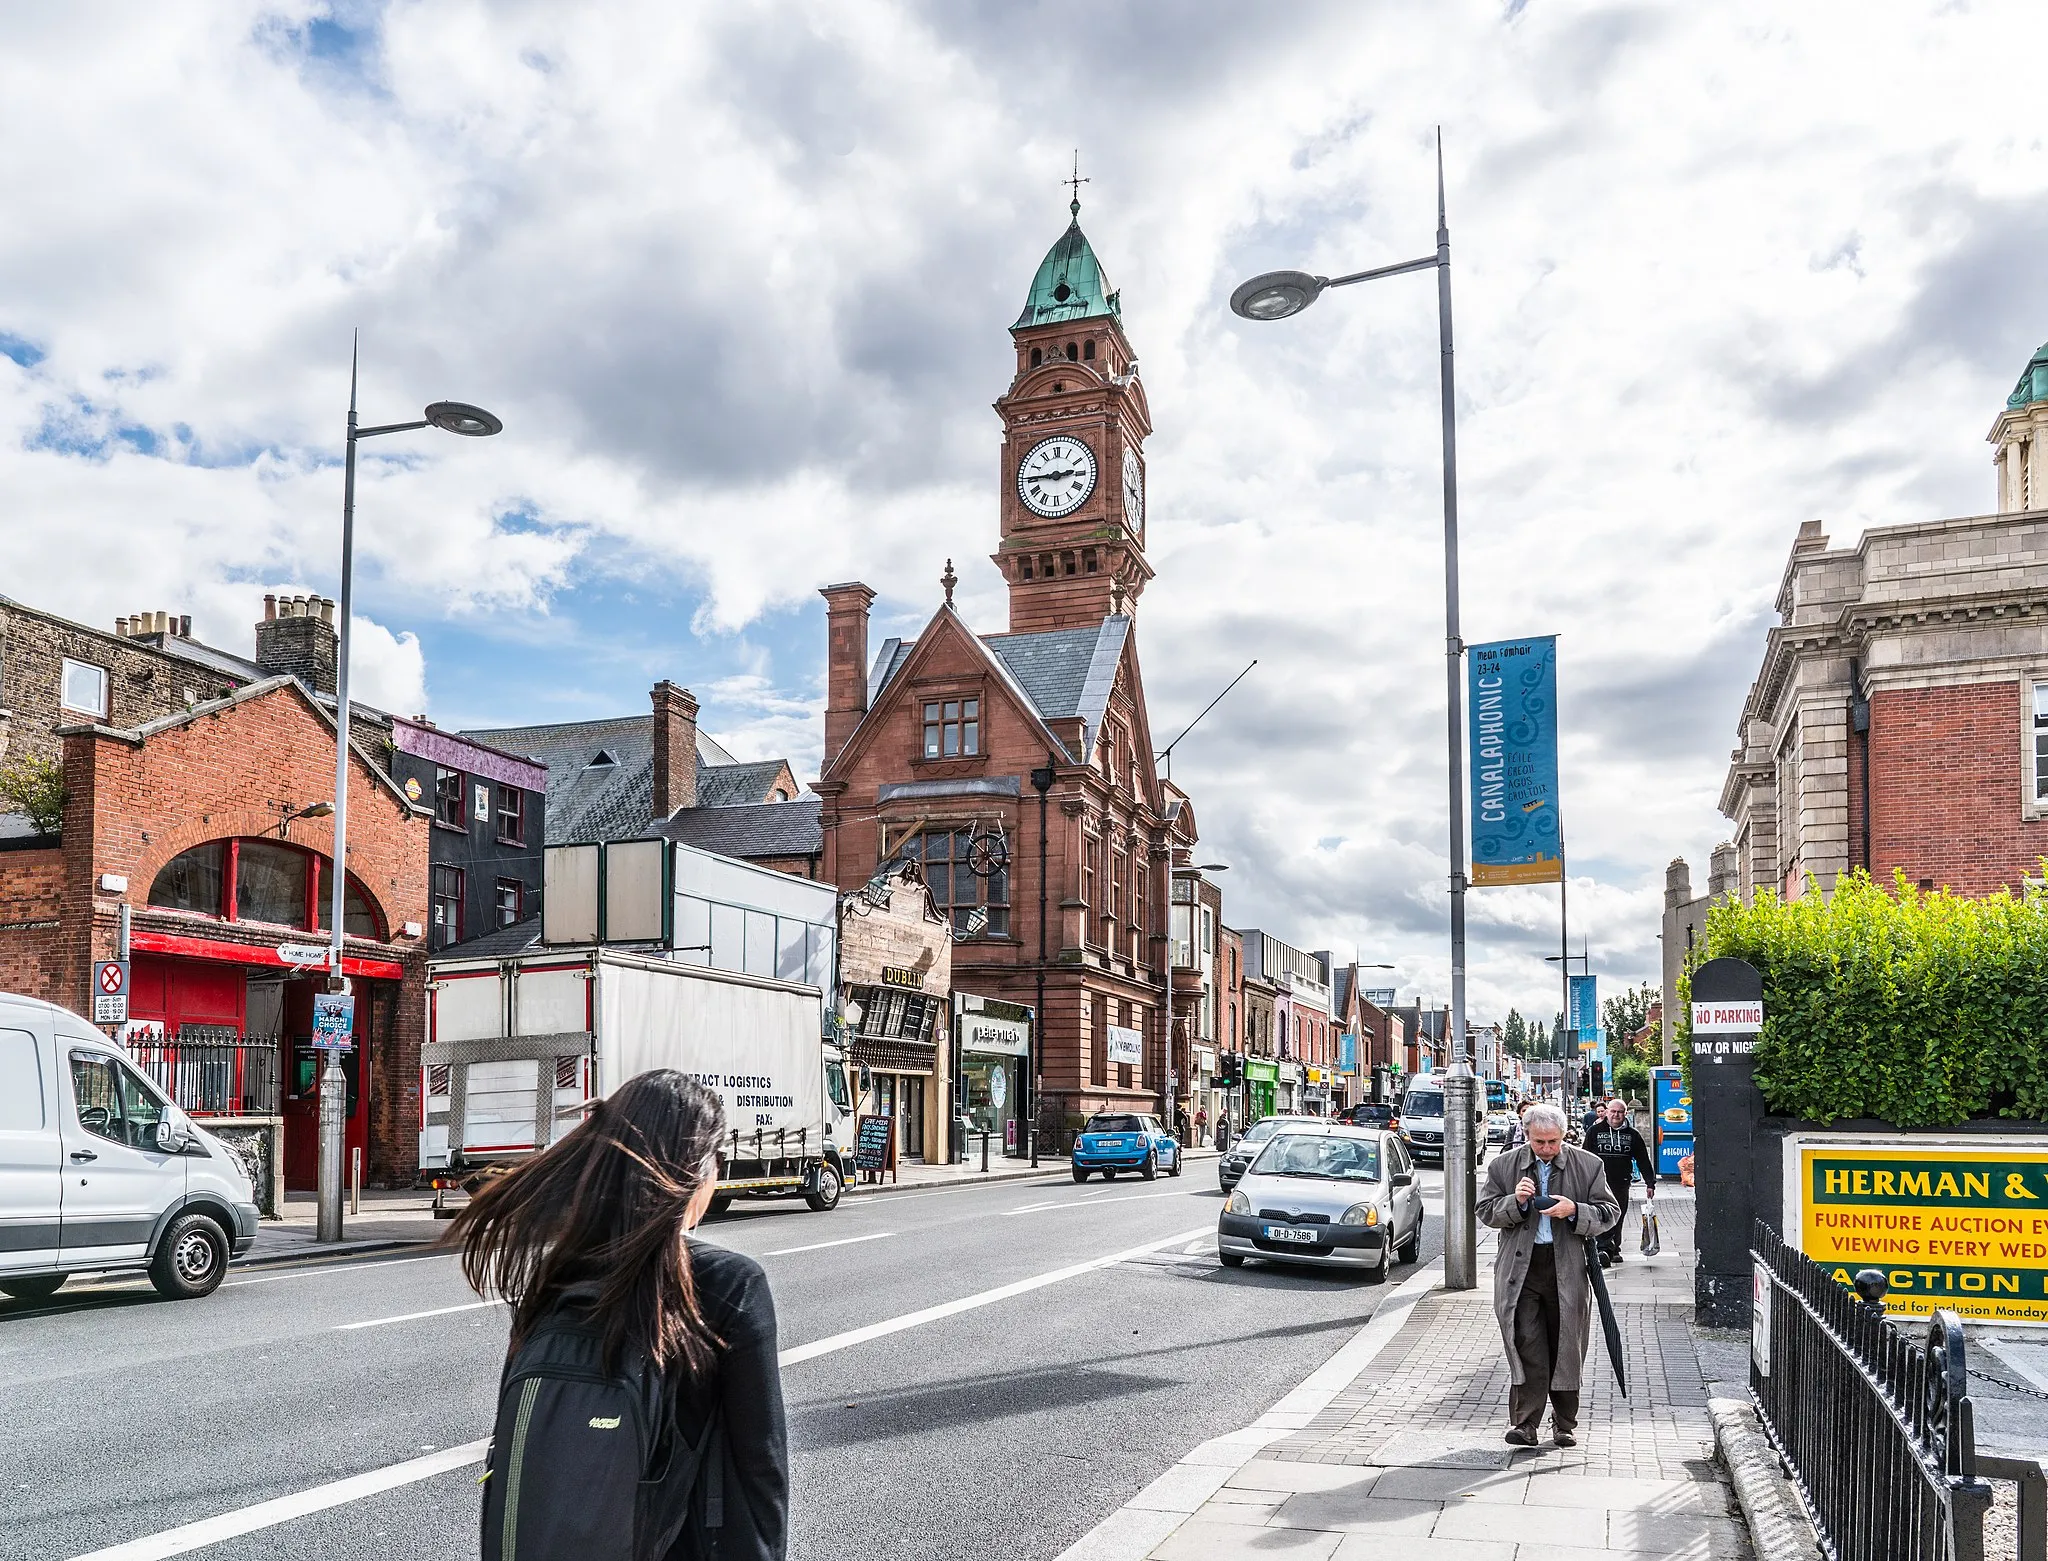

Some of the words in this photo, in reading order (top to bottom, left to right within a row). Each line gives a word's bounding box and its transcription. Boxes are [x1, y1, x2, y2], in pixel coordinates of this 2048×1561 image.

[1477, 662, 1500, 675] 23-24
[1479, 677, 1505, 822] CANALAPHONIC
[886, 967, 923, 988] DUBLIN
[1696, 1009, 1710, 1024] NO
[1714, 1008, 1760, 1024] PARKING
[1694, 1041, 1713, 1055] DAY
[1715, 1041, 1730, 1054] OR
[723, 1075, 772, 1089] LOGISTICS
[736, 1095, 794, 1108] DISTRIBUTION
[756, 1114, 773, 1126] FAX:
[1597, 1144, 1631, 1152] 1992
[1824, 1169, 1990, 1199] HERMAN
[2004, 1173, 2040, 1199] &
[1815, 1213, 1922, 1231] FURNITURE
[1930, 1216, 2023, 1234] AUCTION
[1273, 1229, 1312, 1241] 01-D-7586
[1831, 1236, 1920, 1254] VIEWING
[1928, 1240, 1991, 1257] EVERY
[1999, 1243, 2047, 1259] WED
[1831, 1268, 2020, 1293] ACTION
[1911, 1301, 1929, 1312] for
[1996, 1306, 2048, 1321] Monday
